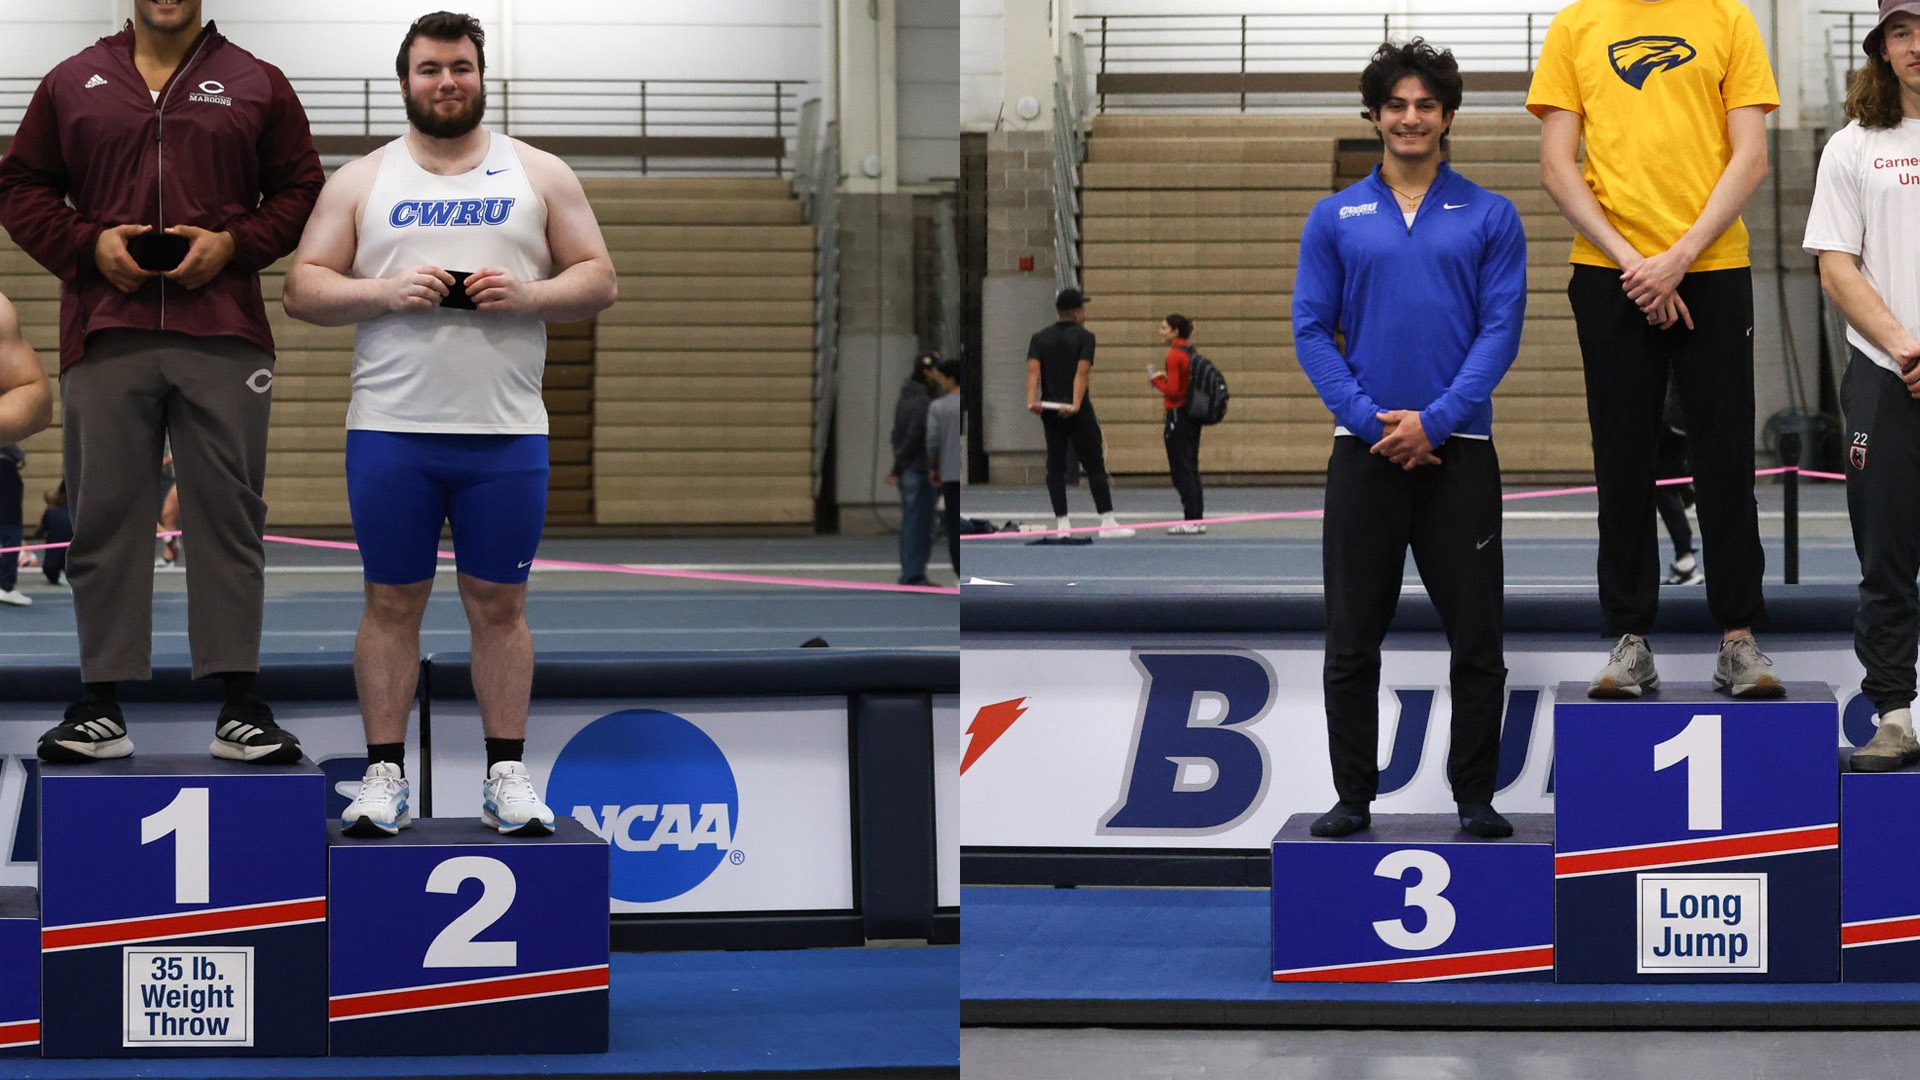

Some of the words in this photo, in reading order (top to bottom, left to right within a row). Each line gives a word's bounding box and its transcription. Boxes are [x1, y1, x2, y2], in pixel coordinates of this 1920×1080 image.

[189, 95, 232, 107] MAROONS
[1874, 157, 1920, 170] Carne
[389, 198, 515, 228] CWRU
[1853, 431, 1868, 446] 22
[1095, 645, 1279, 836] B
[1654, 714, 1722, 831] 1
[141, 787, 209, 904] 1
[571, 803, 732, 852] NCAA
[422, 855, 518, 968] 2
[1372, 849, 1457, 951] 3
[1660, 887, 1742, 926] Long
[1652, 926, 1749, 964] Jump
[151, 956, 183, 981] 35
[192, 956, 224, 981] lb.
[140, 983, 235, 1014] Weight
[144, 1011, 230, 1036] Throw
